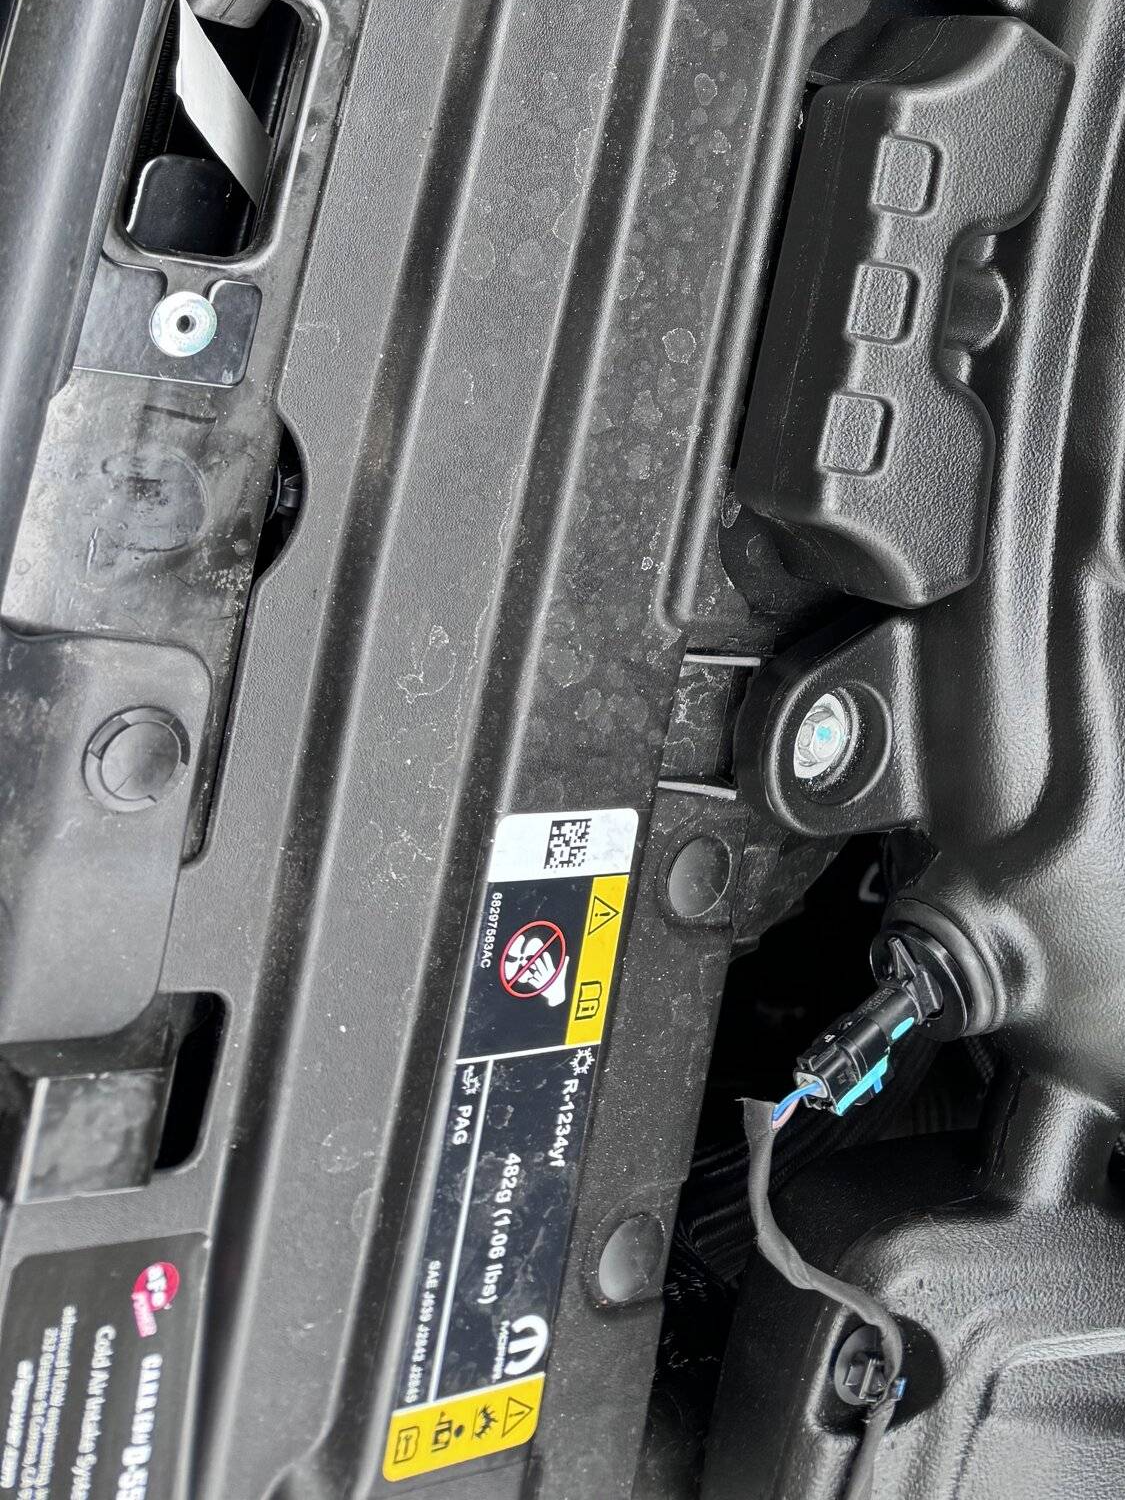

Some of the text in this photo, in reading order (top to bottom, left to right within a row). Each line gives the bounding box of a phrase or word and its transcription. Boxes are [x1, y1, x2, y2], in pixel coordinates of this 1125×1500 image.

[451, 1104, 473, 1145] PAG
[549, 1078, 580, 1167] R-1234yf
[477, 1152, 522, 1304] 482g (1.06 lbs)
[423, 1260, 442, 1289] SAE
